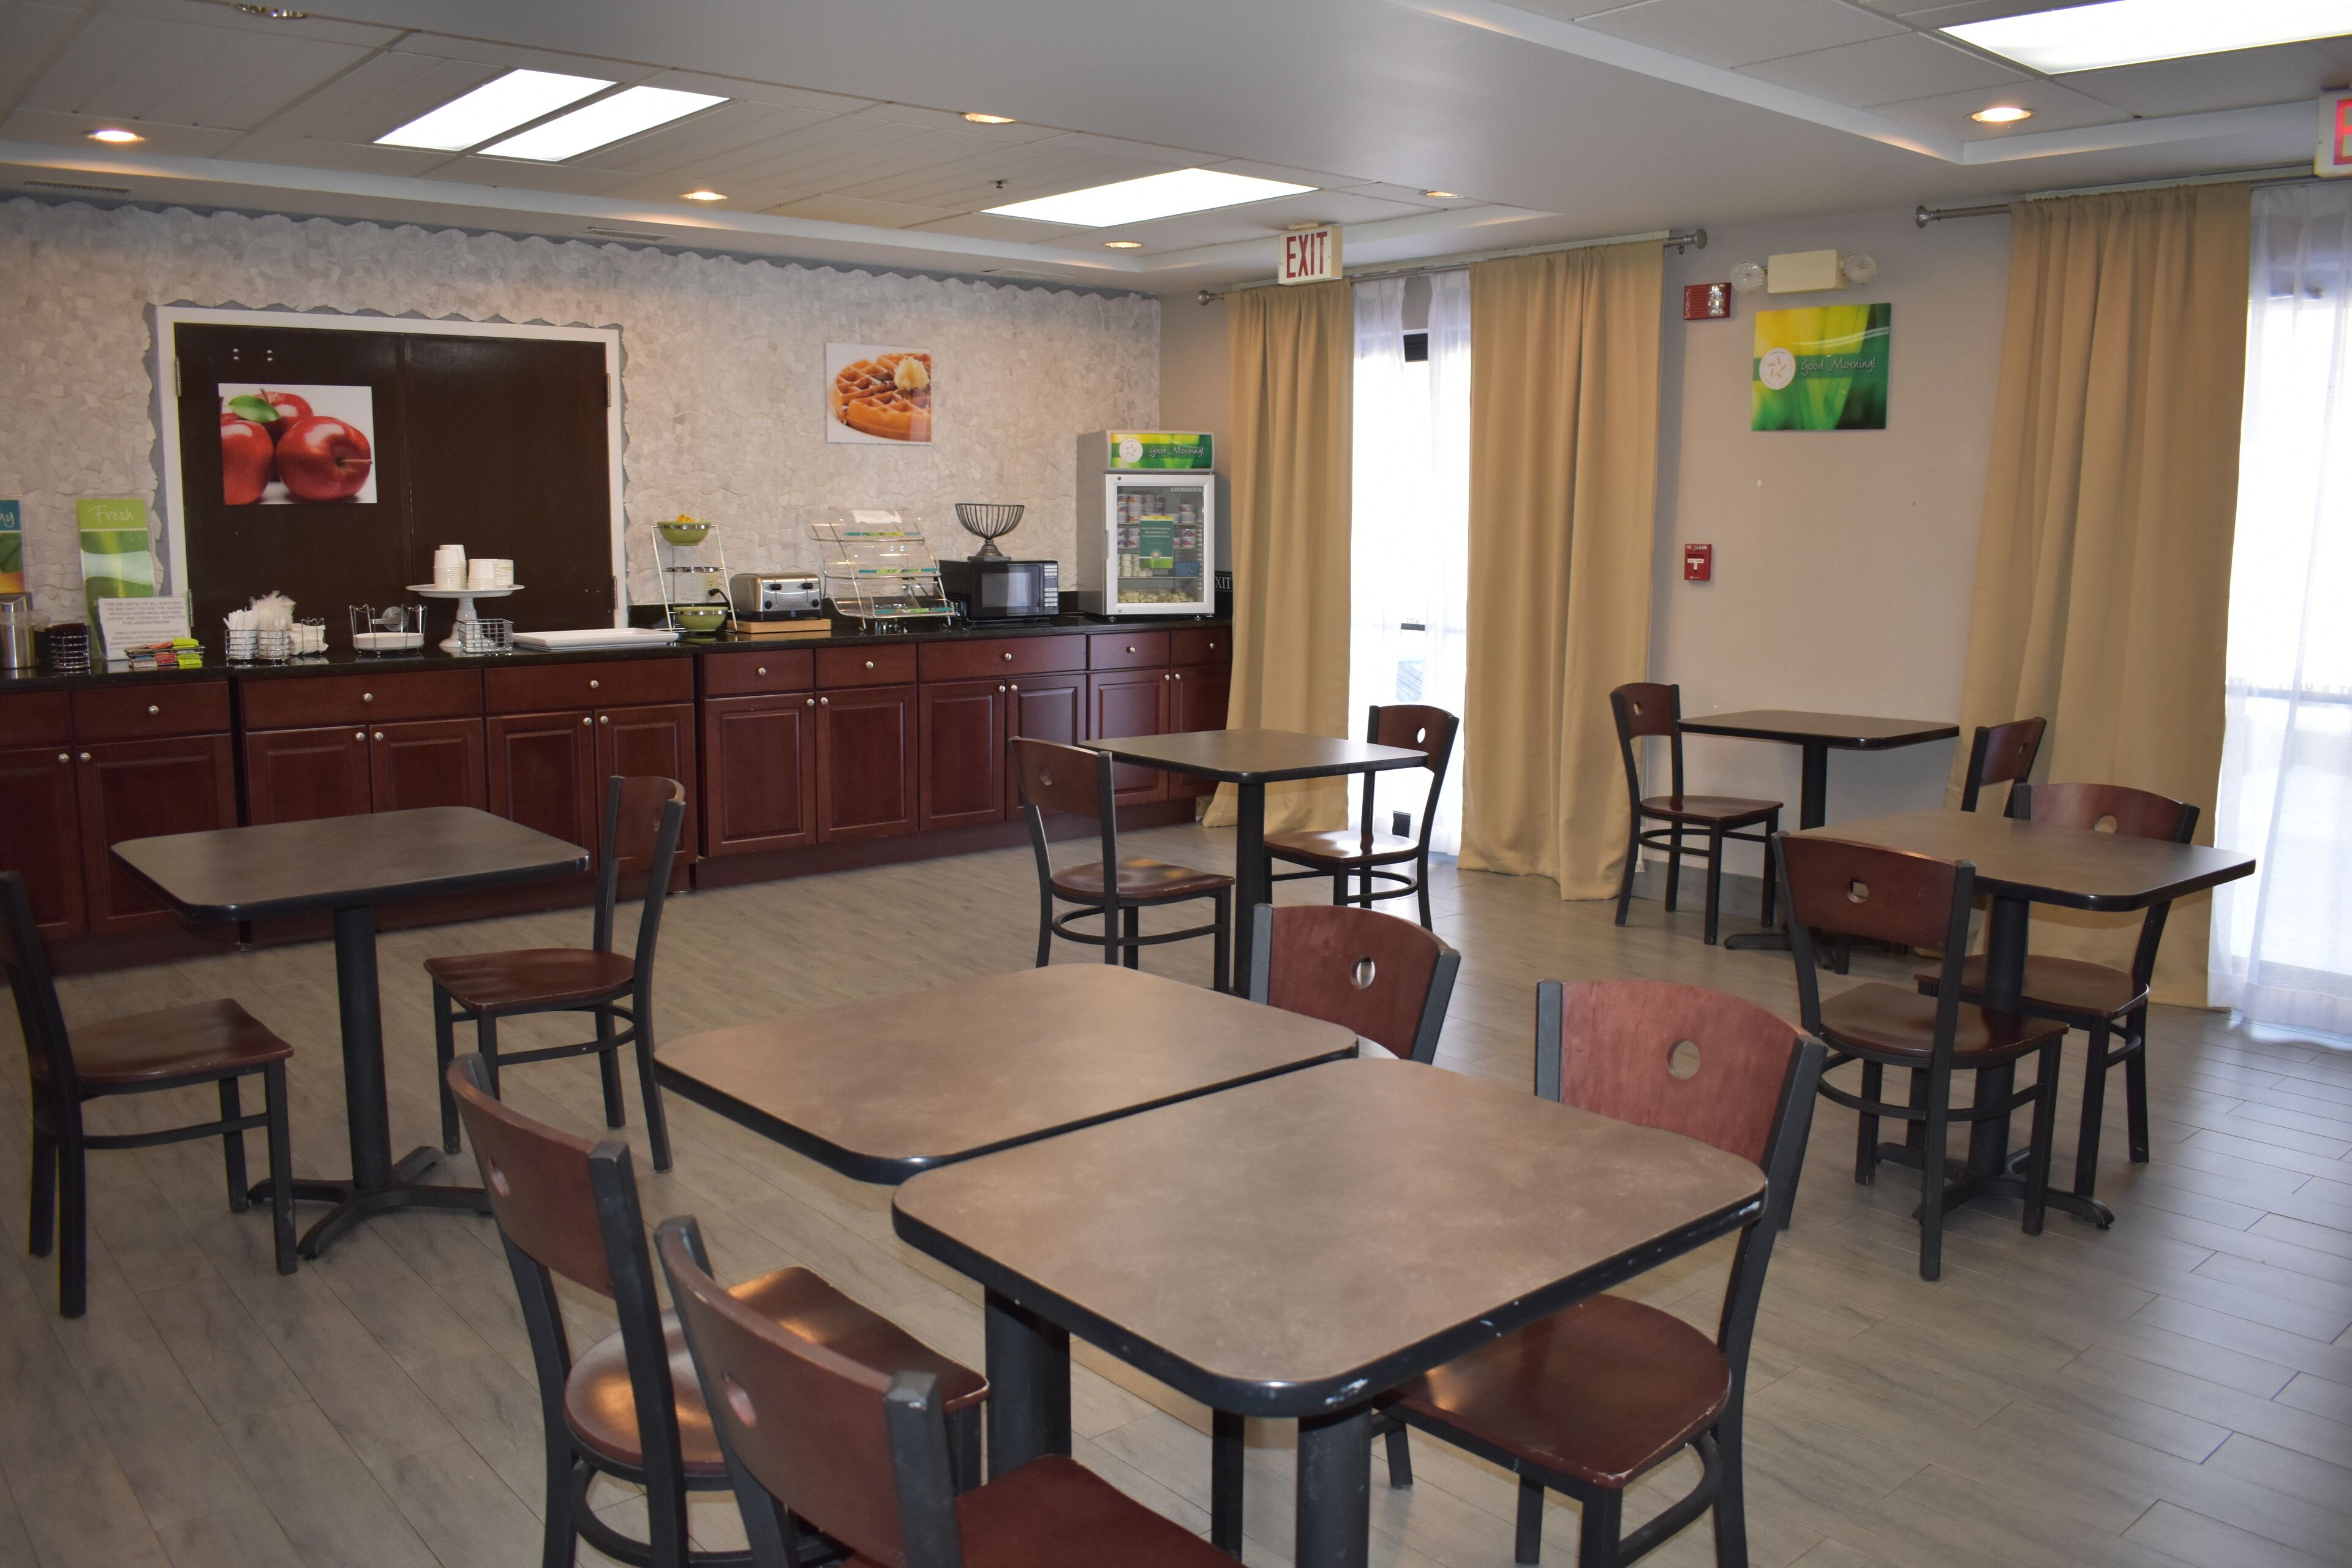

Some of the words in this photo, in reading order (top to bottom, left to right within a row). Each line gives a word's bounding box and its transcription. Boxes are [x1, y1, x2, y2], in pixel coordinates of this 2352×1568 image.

[1286, 231, 1328, 278] EXIT
[1801, 359, 1823, 376] Good
[1826, 358, 1876, 372] Morning!
[1150, 445, 1166, 458] Good
[1169, 445, 1204, 458] Morning!
[88, 505, 134, 522] Fresh
